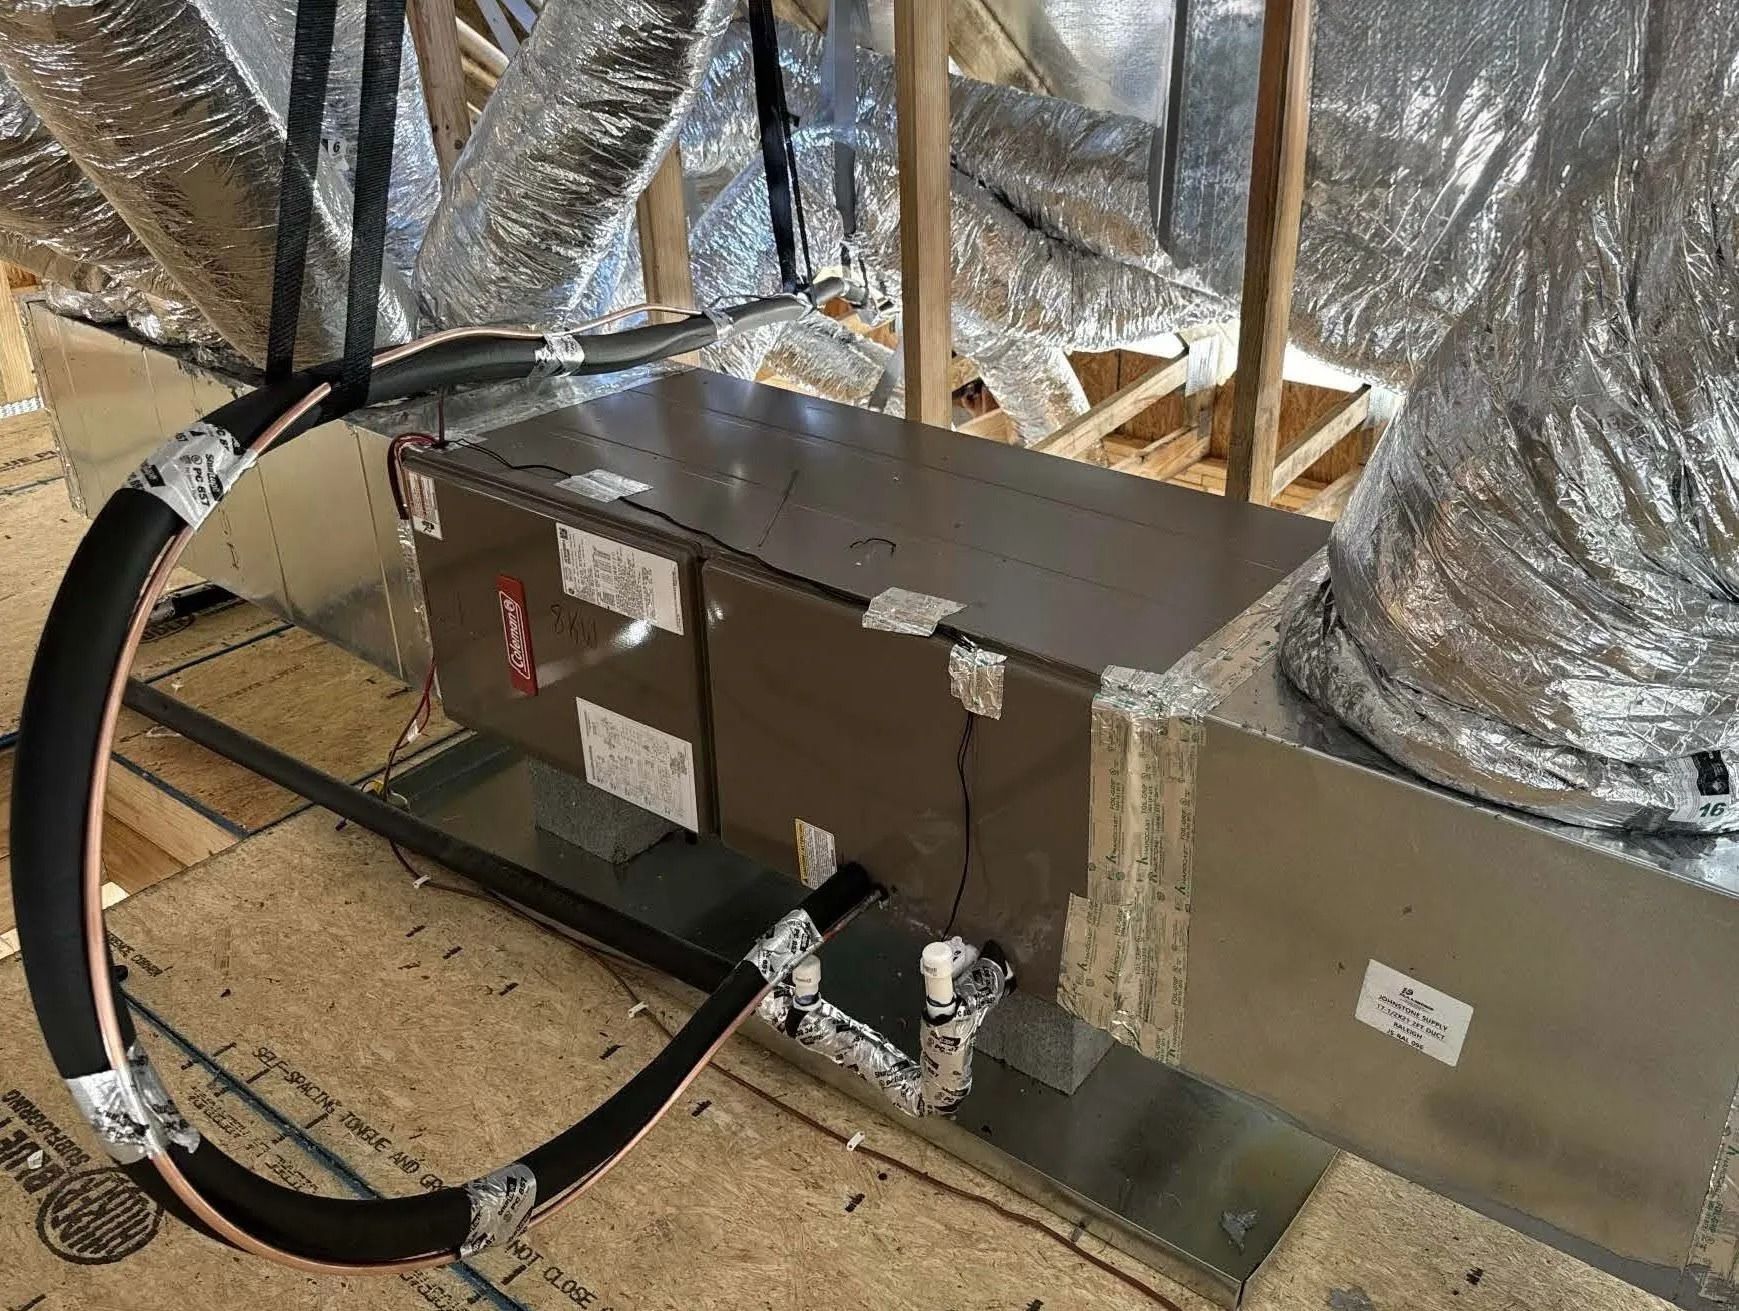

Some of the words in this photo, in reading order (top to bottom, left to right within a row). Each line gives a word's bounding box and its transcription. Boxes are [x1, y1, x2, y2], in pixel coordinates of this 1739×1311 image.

[193, 467, 203, 482] PC
[507, 612, 524, 669] Coleman
[1699, 802, 1727, 817] 16
[1378, 994, 1422, 1019] JOHNSTONE
[1422, 1014, 1449, 1031] SUPPLY
[1393, 1021, 1423, 1040] RALEIGH
[1425, 1027, 1445, 1041] DUCT
[1, 1089, 90, 1166] SUBFLOORING
[253, 1046, 342, 1115] SELF-SPACING
[340, 1111, 392, 1153] TONGUE
[389, 1151, 420, 1174] AND
[509, 1239, 544, 1266] NOT
[543, 1266, 598, 1310] CLOSE
